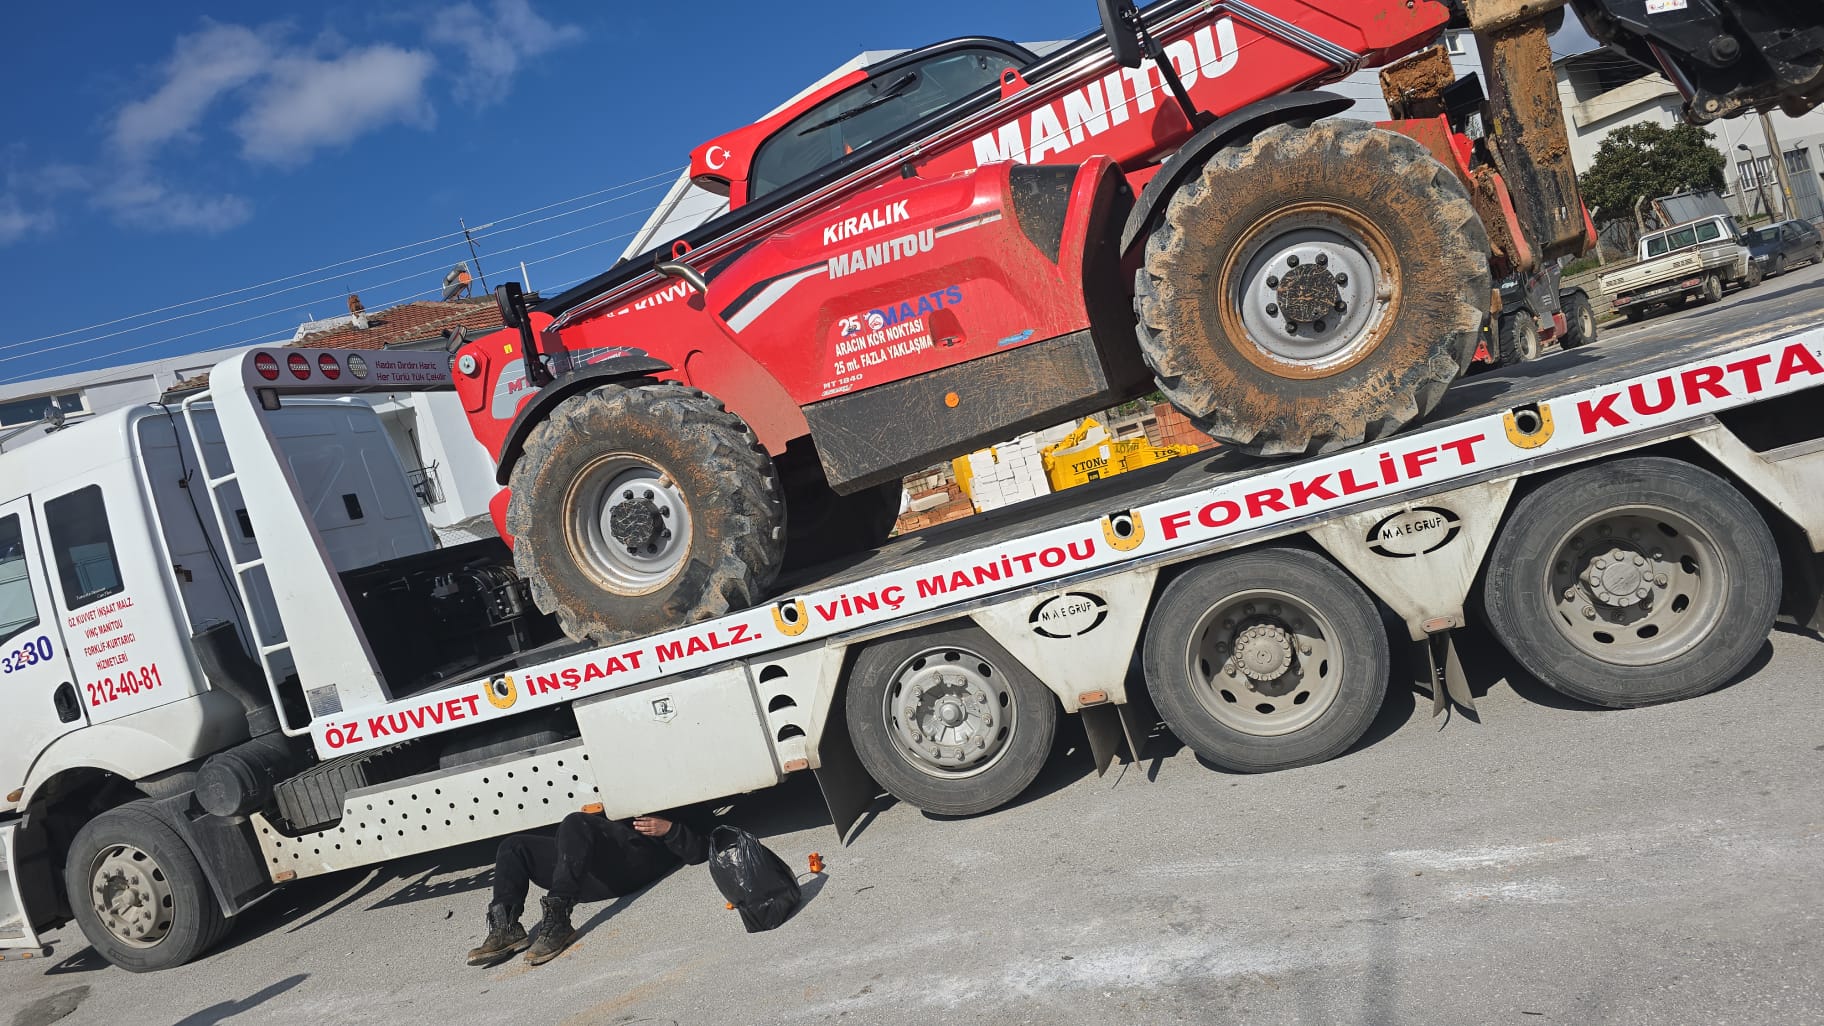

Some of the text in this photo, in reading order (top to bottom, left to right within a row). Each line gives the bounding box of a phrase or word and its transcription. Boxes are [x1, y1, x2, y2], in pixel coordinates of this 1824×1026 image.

[971, 16, 1239, 168] MANITOU
[828, 228, 935, 280] MANITOU
[834, 334, 934, 376] 25 mt. FAZLA YAKLAŞMA
[835, 336, 867, 358] ARACIN
[885, 318, 924, 342] NOKTASI
[376, 373, 390, 381] Her
[1577, 342, 1824, 435] KURTA
[1072, 458, 1108, 473] YTONG
[1159, 433, 1486, 540] FORKLİFT
[815, 538, 1096, 622] VİNÇ MANİTOU
[75, 610, 97, 626] KUVVET
[2, 635, 53, 674] 3230
[525, 623, 763, 697] İNŞAAT MALZ.
[87, 663, 162, 706] 212-40-81
[325, 722, 363, 749] ÖZ
[367, 694, 480, 739] KUVVET
